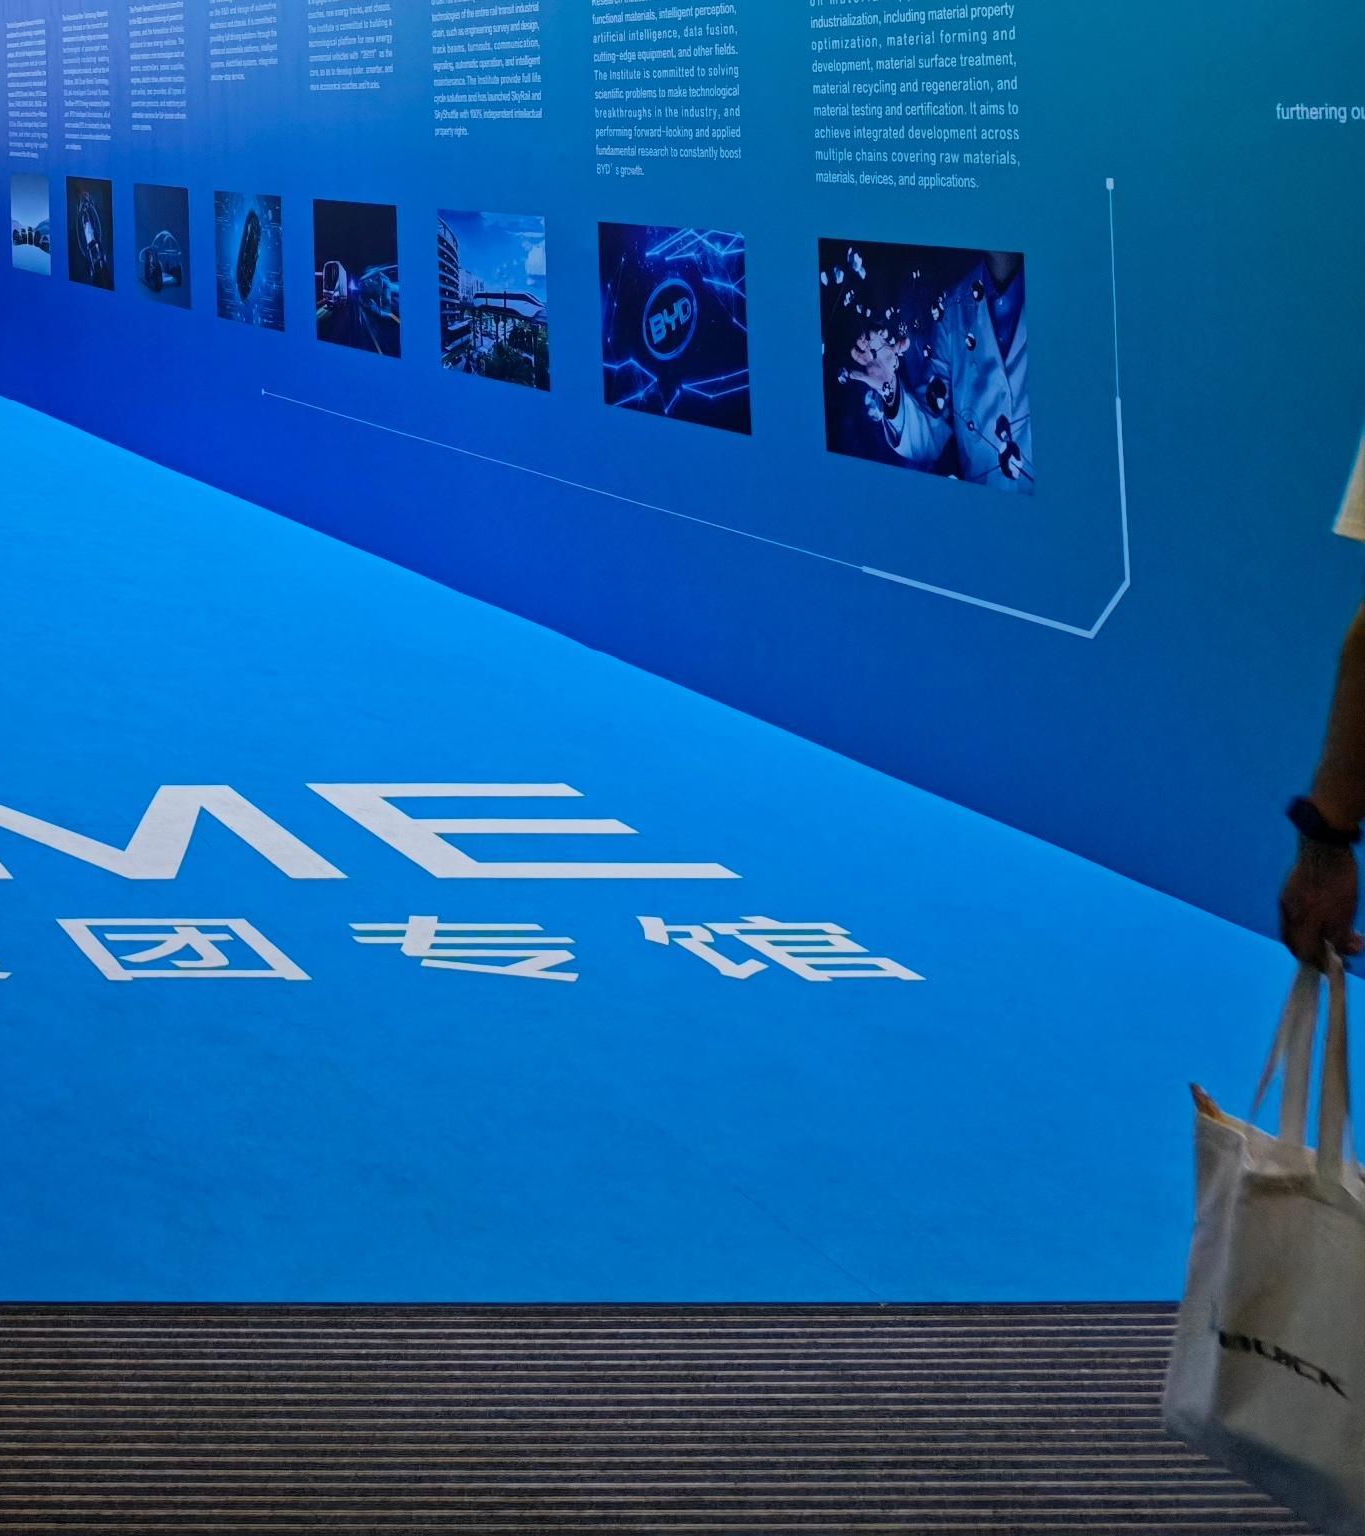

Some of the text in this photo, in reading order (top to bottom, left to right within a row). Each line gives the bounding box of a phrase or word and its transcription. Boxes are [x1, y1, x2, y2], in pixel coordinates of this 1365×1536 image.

[810, 2, 1013, 28] industrialization, including material property
[593, 29, 625, 43] artificial
[683, 25, 702, 37] data
[811, 26, 1015, 52] optimization, material forming and
[812, 51, 1015, 73] development, material surface treatment,
[813, 75, 1017, 96] material recycling and regeneration, and
[813, 101, 1018, 118] material testing and certification. It aims to
[1276, 103, 1347, 123] furthering
[815, 125, 1018, 142] achieve integrated development across
[815, 147, 1019, 166] multiple chains covering raw materials,
[816, 169, 978, 189] materials, devices, and applications.
[650, 296, 691, 345] BYD
